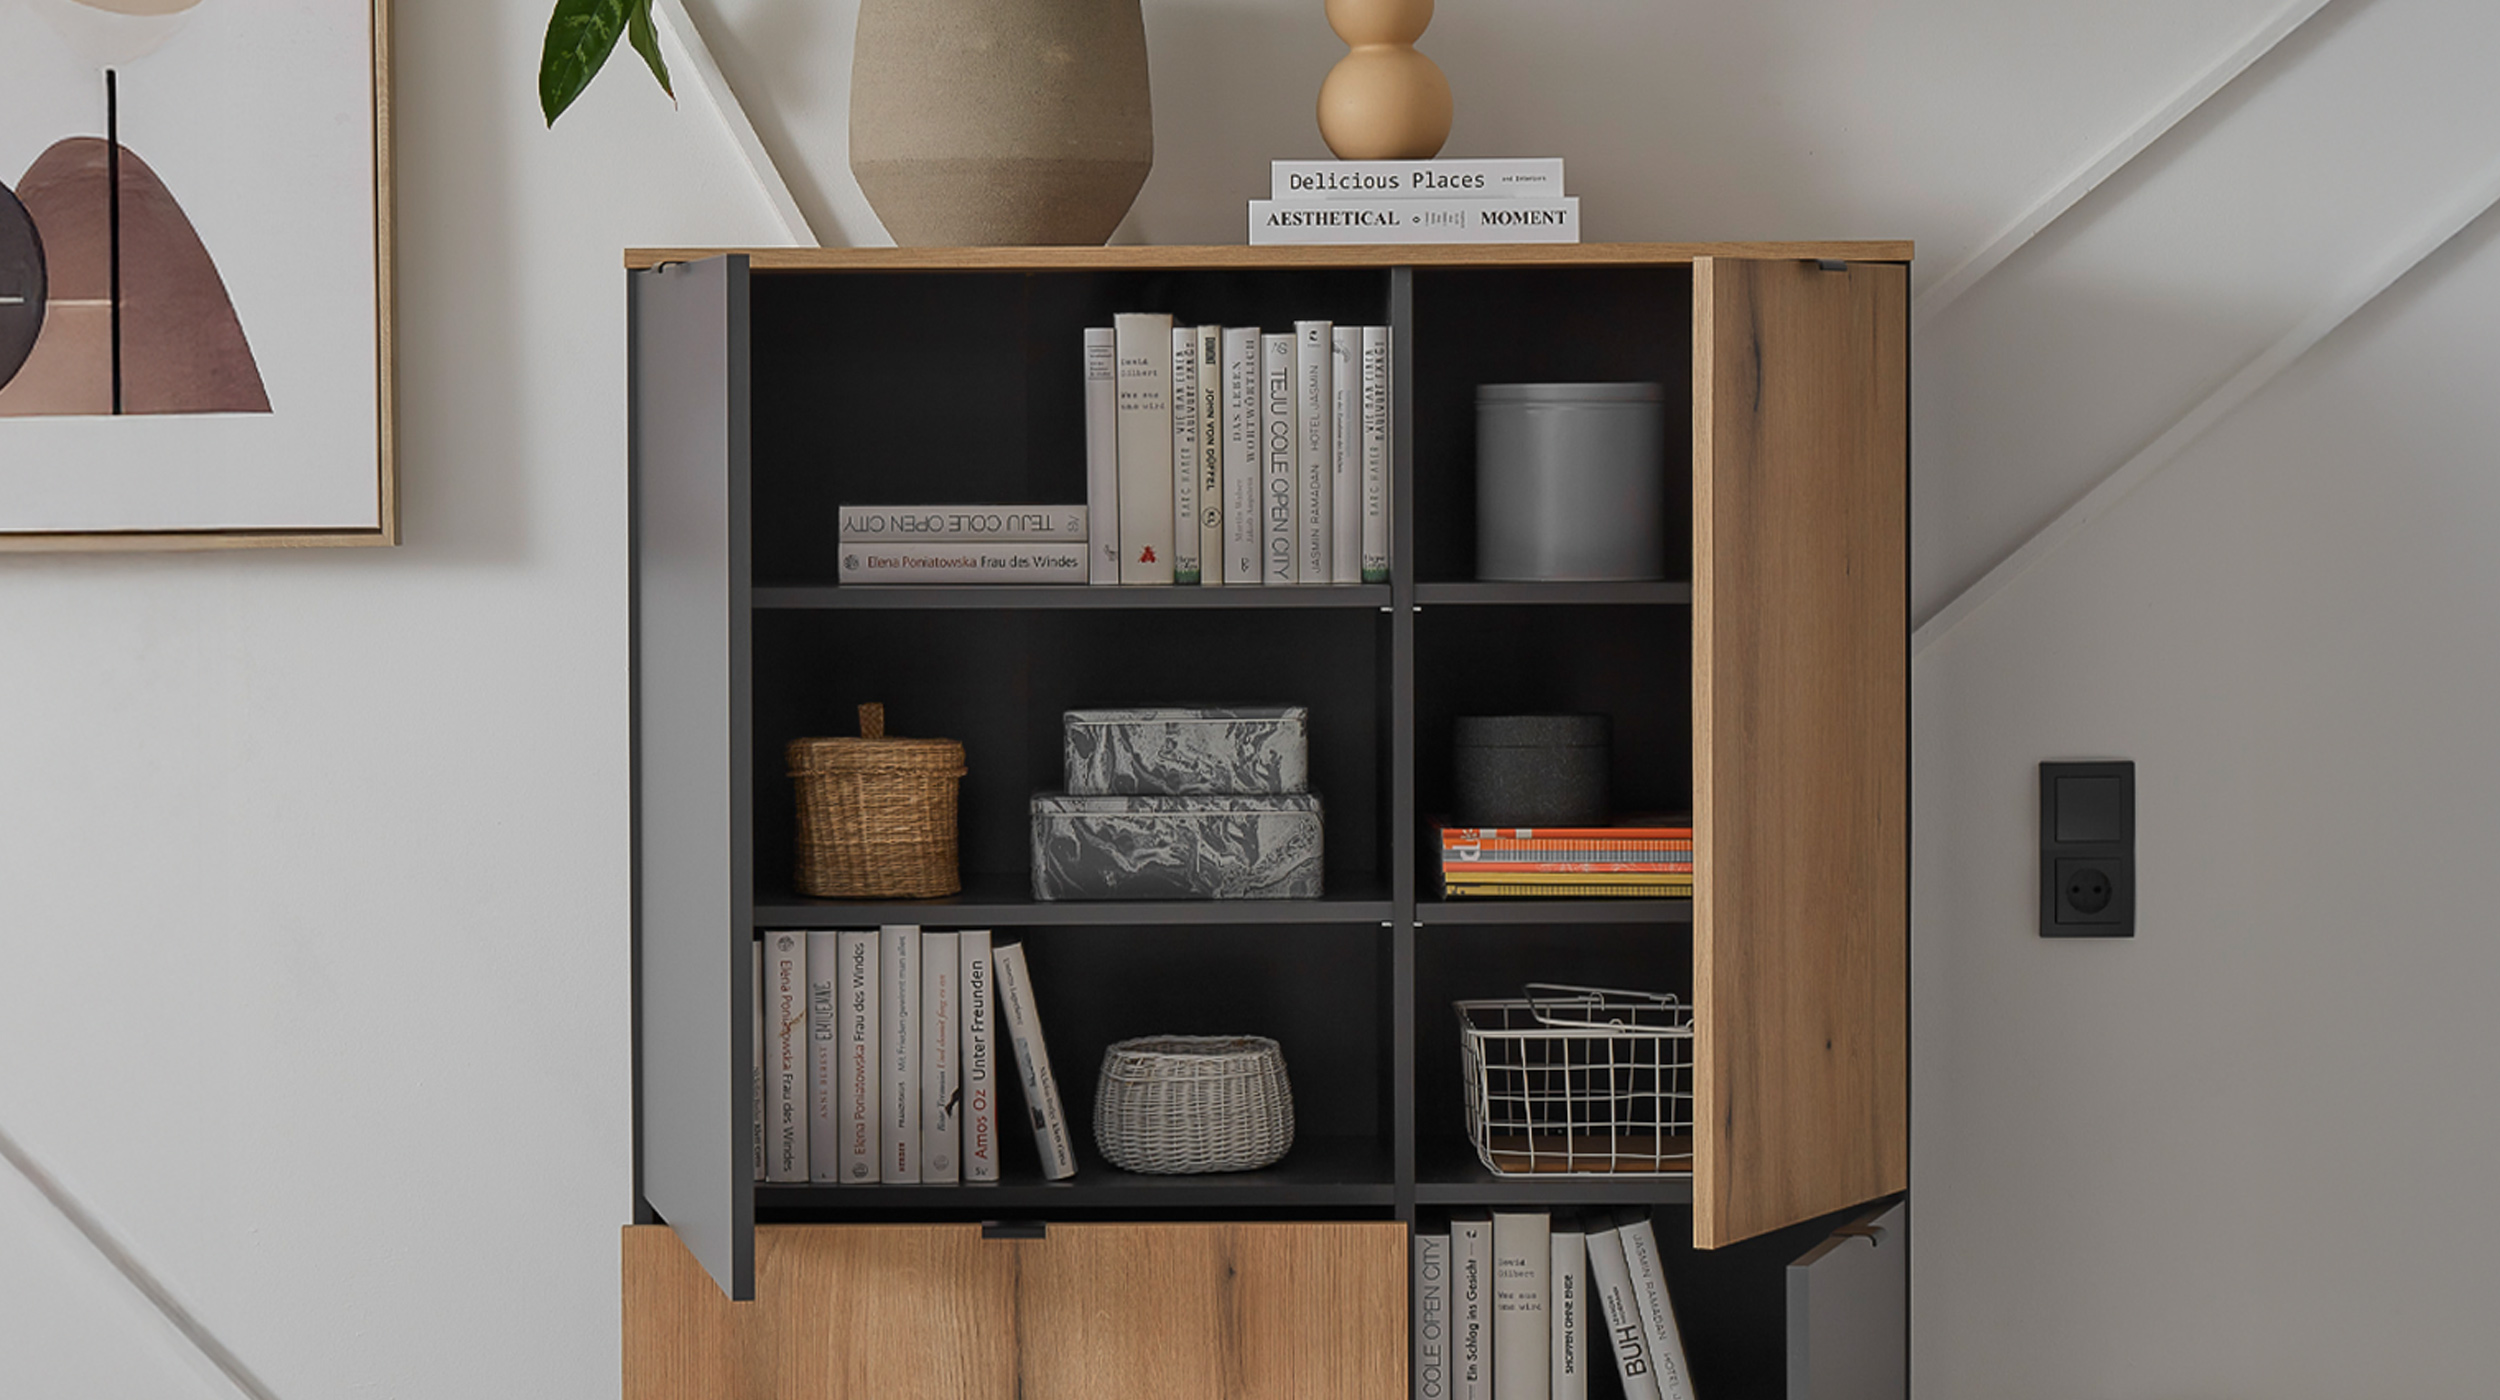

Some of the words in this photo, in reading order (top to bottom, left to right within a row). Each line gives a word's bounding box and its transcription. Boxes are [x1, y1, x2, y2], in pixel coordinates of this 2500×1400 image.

[1290, 172, 1400, 190] Delicious
[1412, 171, 1485, 189] Places
[1266, 211, 1400, 227] AESTHETICAL
[1481, 210, 1567, 226] MOMENT
[1232, 360, 1241, 408] LEBEN
[1271, 367, 1288, 415] TEJU
[1309, 364, 1319, 410] JASMIN
[1205, 388, 1215, 419] JOHN
[1206, 422, 1215, 445] VON
[1233, 414, 1242, 442] DAS
[1309, 414, 1320, 451] HOTEL
[1271, 420, 1289, 473] COLE
[1272, 478, 1290, 532] OPEN
[1310, 464, 1320, 524] RAMADAN
[843, 515, 885, 532] CITY
[891, 515, 944, 532] OPEN
[949, 515, 1002, 532] COLE
[1007, 515, 1054, 531] TEJU
[867, 556, 899, 568] Elena
[902, 556, 977, 569] Poniatowska
[981, 556, 1006, 568] Frau
[1009, 556, 1029, 568] des
[1033, 556, 1079, 568] Windes
[1272, 538, 1290, 579] CITY
[1310, 528, 1321, 574] JASMIN
[780, 960, 793, 991] Elena
[852, 942, 864, 988] Windes
[898, 959, 906, 979] man
[853, 991, 865, 1012] des
[970, 960, 985, 1033] Freunden
[853, 1015, 865, 1042] Frau
[898, 1056, 906, 1072] Mit
[971, 1036, 986, 1081] Unter
[782, 1074, 794, 1099] Frau
[853, 1044, 866, 1121] Poniatowska
[783, 1102, 794, 1124] des
[819, 1089, 828, 1119] ANNE
[973, 1089, 987, 1111] Oz
[783, 1126, 796, 1172] Windes
[854, 1123, 866, 1155] Elena
[974, 1116, 988, 1160] Amos
[1422, 1239, 1440, 1281] CITY
[1466, 1259, 1477, 1301] Gesicht
[1565, 1274, 1574, 1299] ENDE
[1422, 1287, 1440, 1340] OPEN
[1467, 1304, 1477, 1319] ins
[1565, 1301, 1574, 1330] OHNE
[1632, 1233, 1651, 1278] JASMIN
[1646, 1281, 1666, 1341] RAMADAN
[1664, 1353, 1680, 1395] HOTEL
[1465, 1323, 1479, 1361] Schlag
[1565, 1331, 1574, 1374] SHOPPEN
[1615, 1325, 1647, 1377] BUH
[1422, 1346, 1441, 1398] COLE
[1466, 1363, 1477, 1381] Ein
